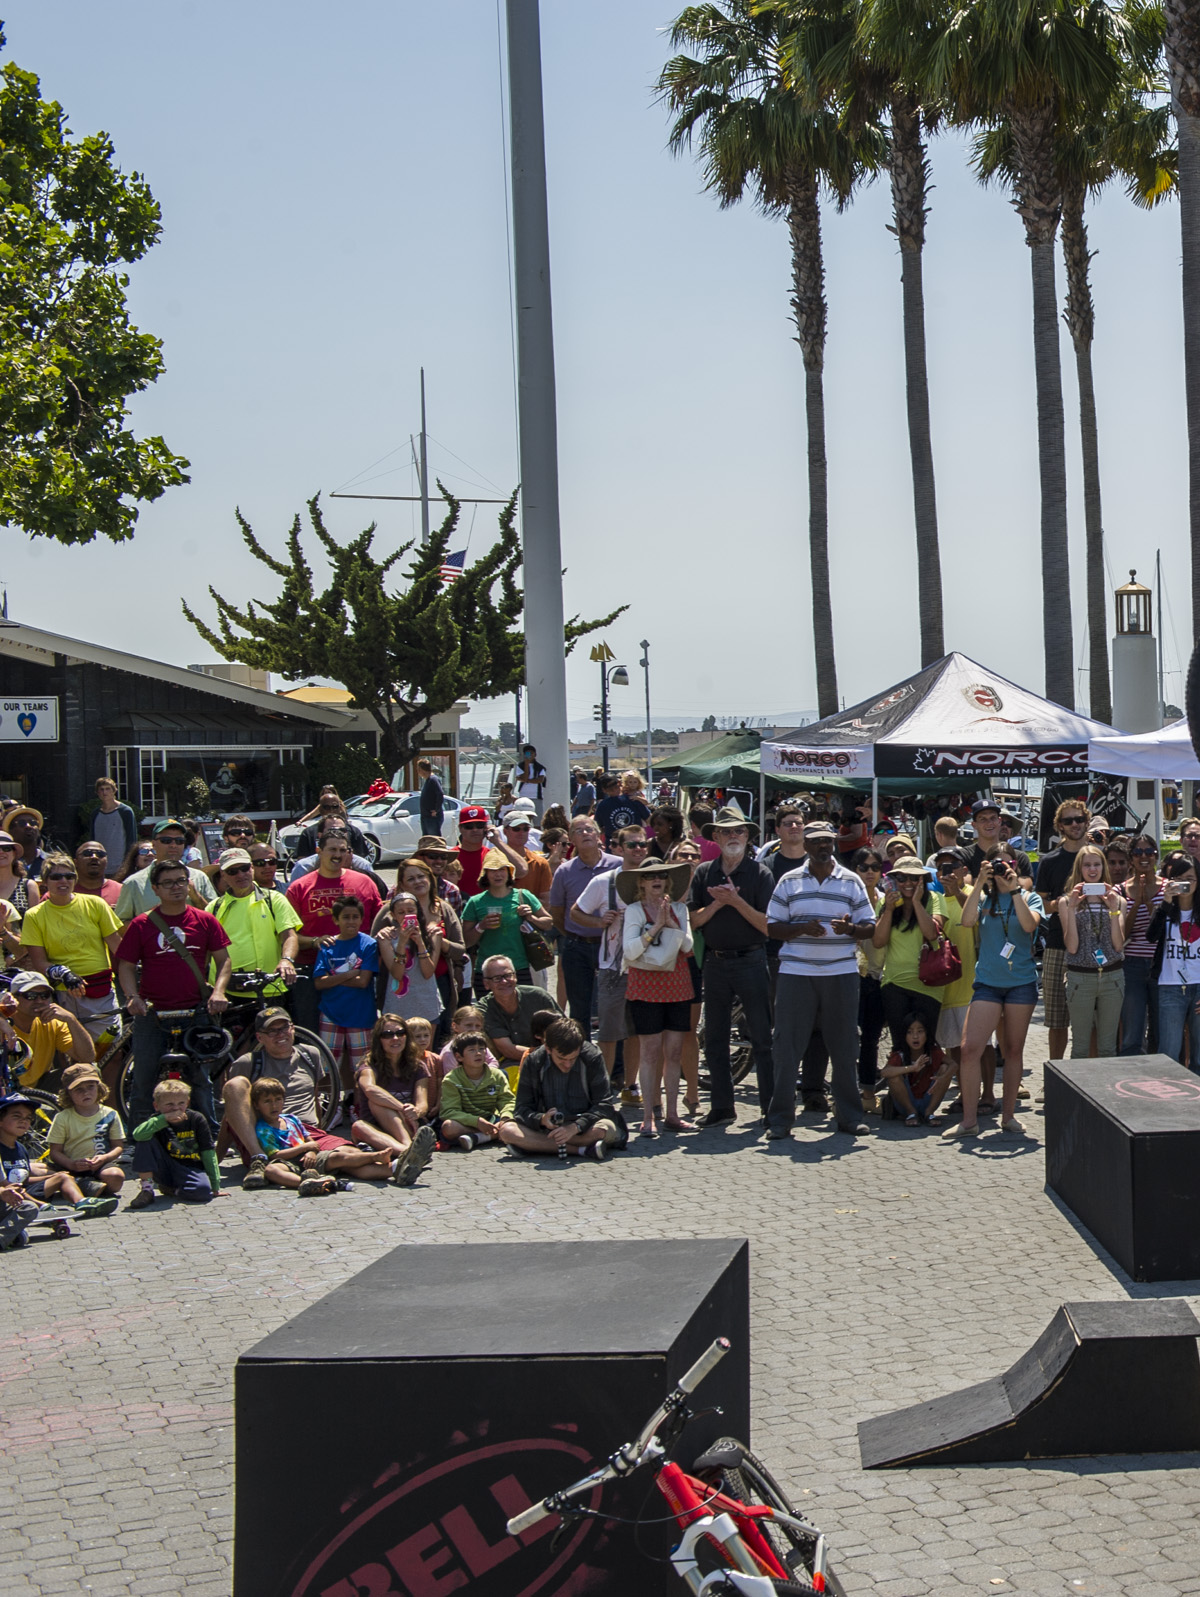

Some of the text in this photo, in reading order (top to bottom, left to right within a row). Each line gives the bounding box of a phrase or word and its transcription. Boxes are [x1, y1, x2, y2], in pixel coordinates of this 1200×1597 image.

[4, 702, 49, 711] OUR TEAMS
[780, 749, 850, 768] NORCO
[785, 766, 825, 774] PERFORMANCE
[948, 767, 1047, 775] PERFORMANCE
[320, 1473, 562, 1597] BELL
